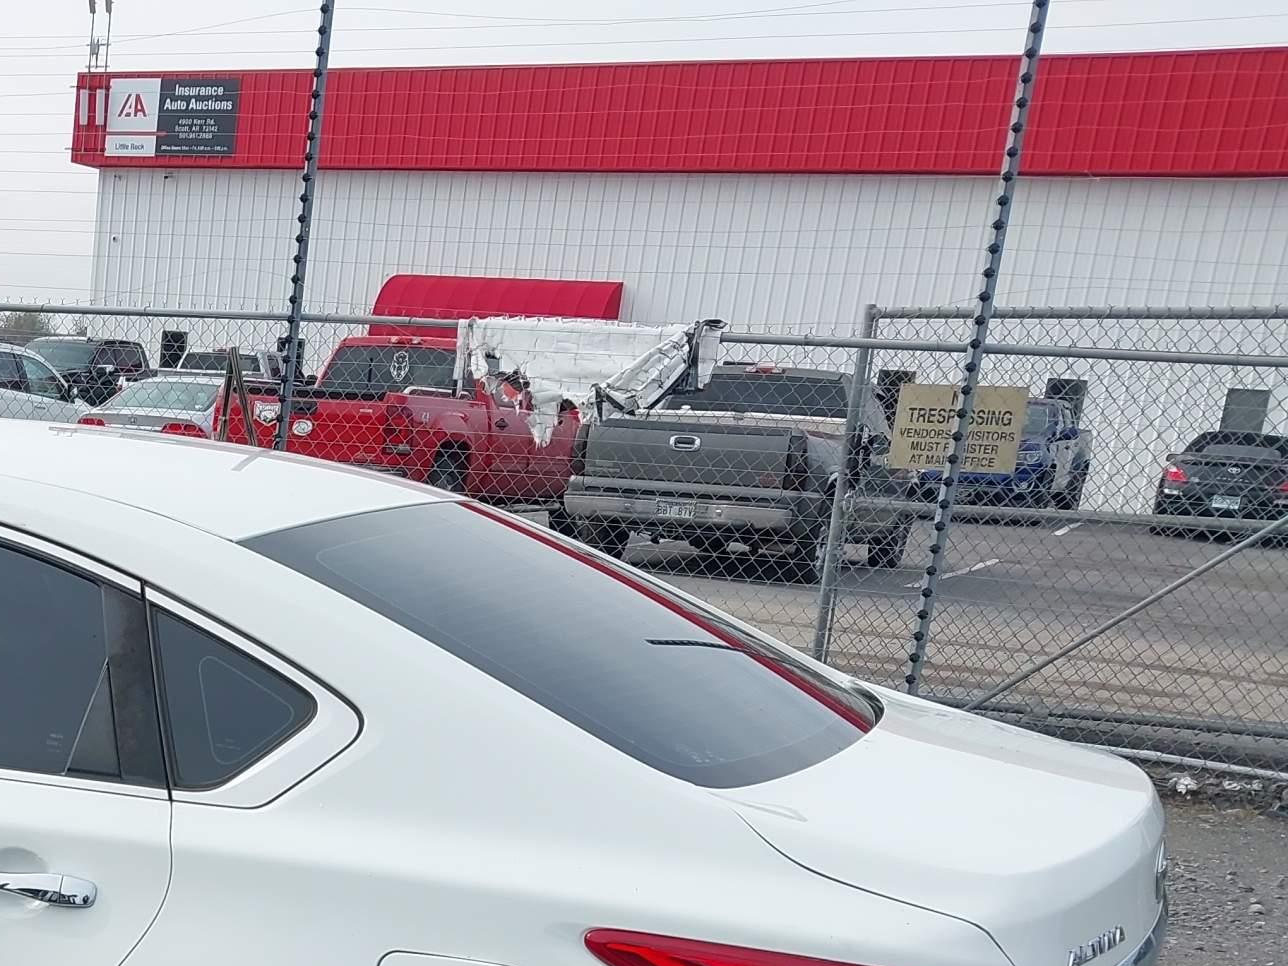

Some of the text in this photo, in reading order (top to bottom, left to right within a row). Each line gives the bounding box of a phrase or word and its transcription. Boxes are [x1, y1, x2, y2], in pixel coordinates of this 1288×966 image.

[175, 83, 224, 96] Insurance
[163, 97, 233, 111] Auto Auctions
[908, 407, 1013, 426] TRESPSSING
[910, 441, 939, 452] MUST
[908, 454, 923, 464] AT
